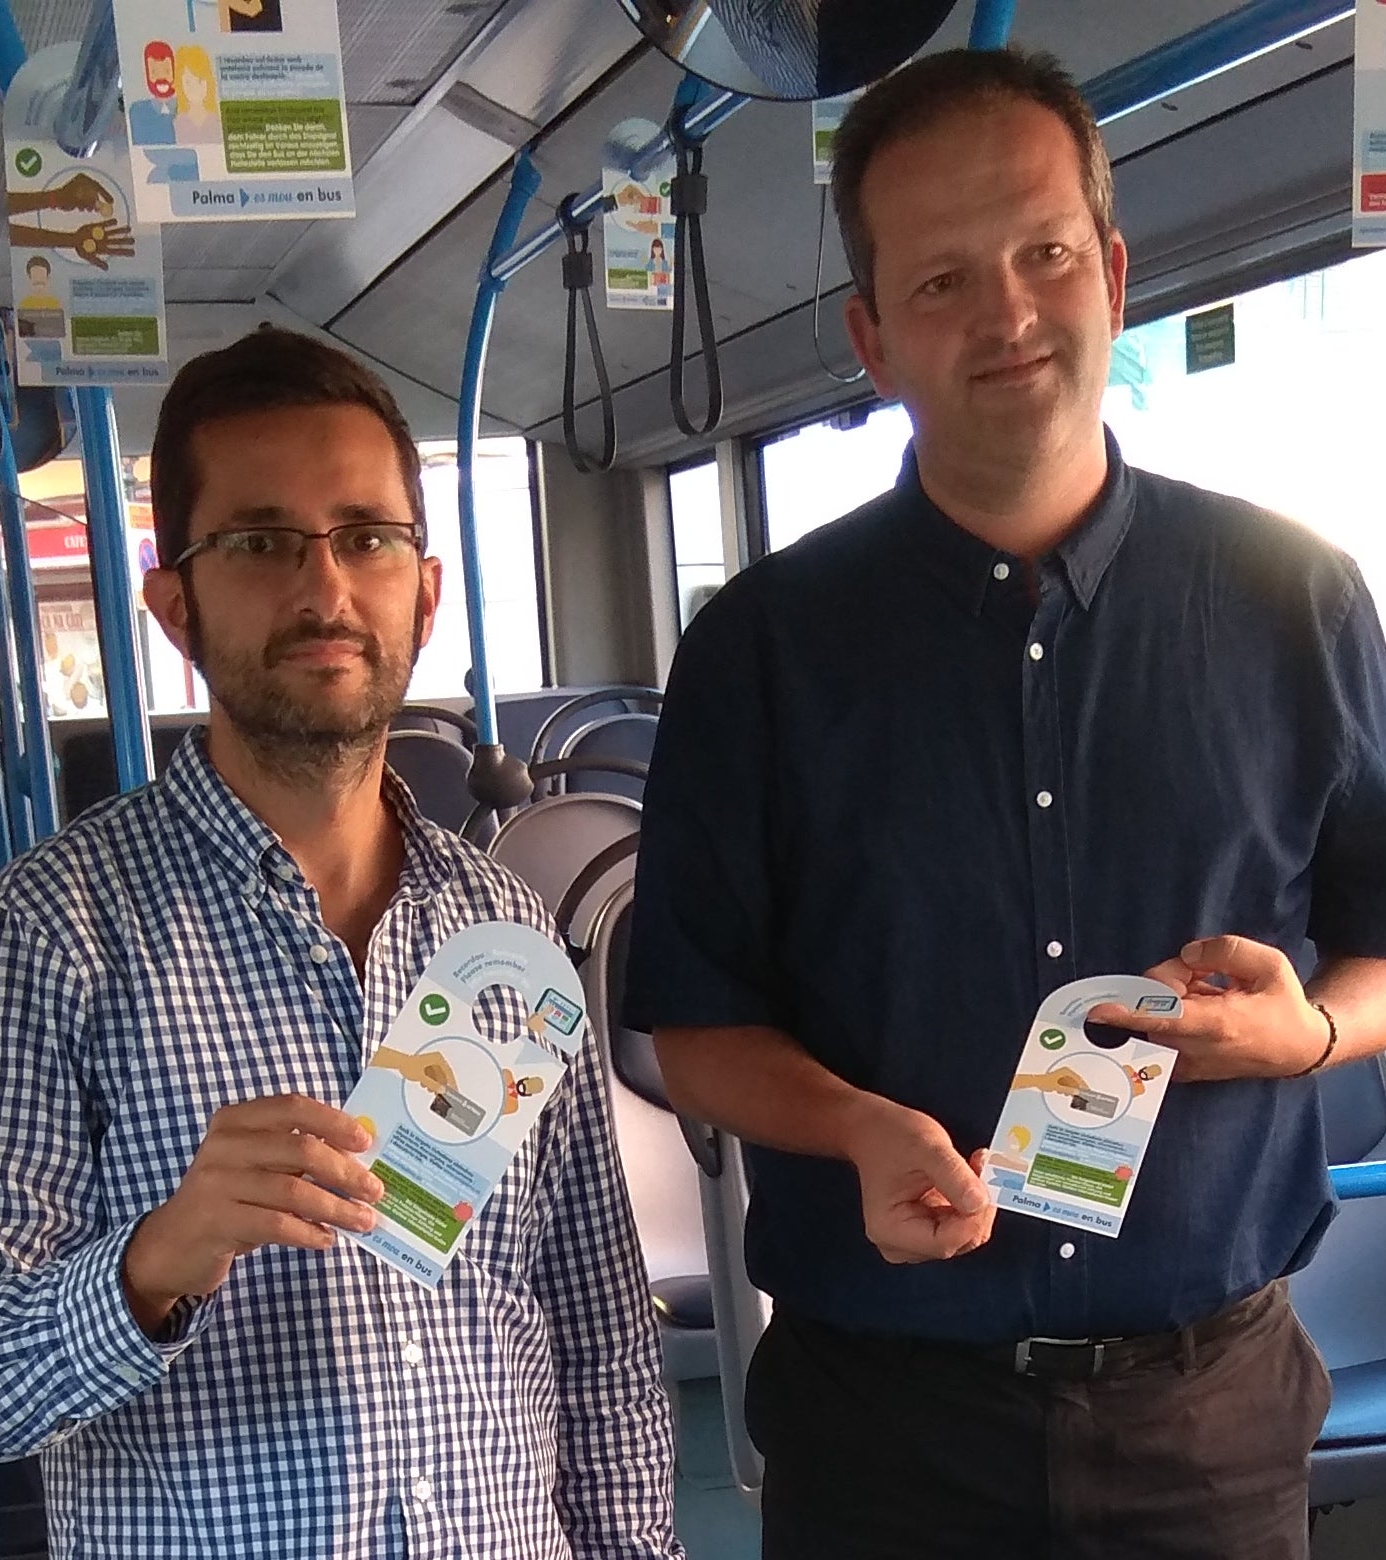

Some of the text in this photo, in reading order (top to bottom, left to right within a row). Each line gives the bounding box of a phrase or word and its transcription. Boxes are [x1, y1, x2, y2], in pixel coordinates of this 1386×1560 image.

[192, 189, 235, 205] Palma
[297, 190, 314, 202] en
[317, 187, 342, 202] bus
[484, 960, 525, 973] remember
[1012, 1194, 1041, 1209] Palma
[1081, 1213, 1094, 1223] en
[1095, 1216, 1113, 1227] bus
[401, 1252, 414, 1265] en
[415, 1260, 433, 1277] bus
